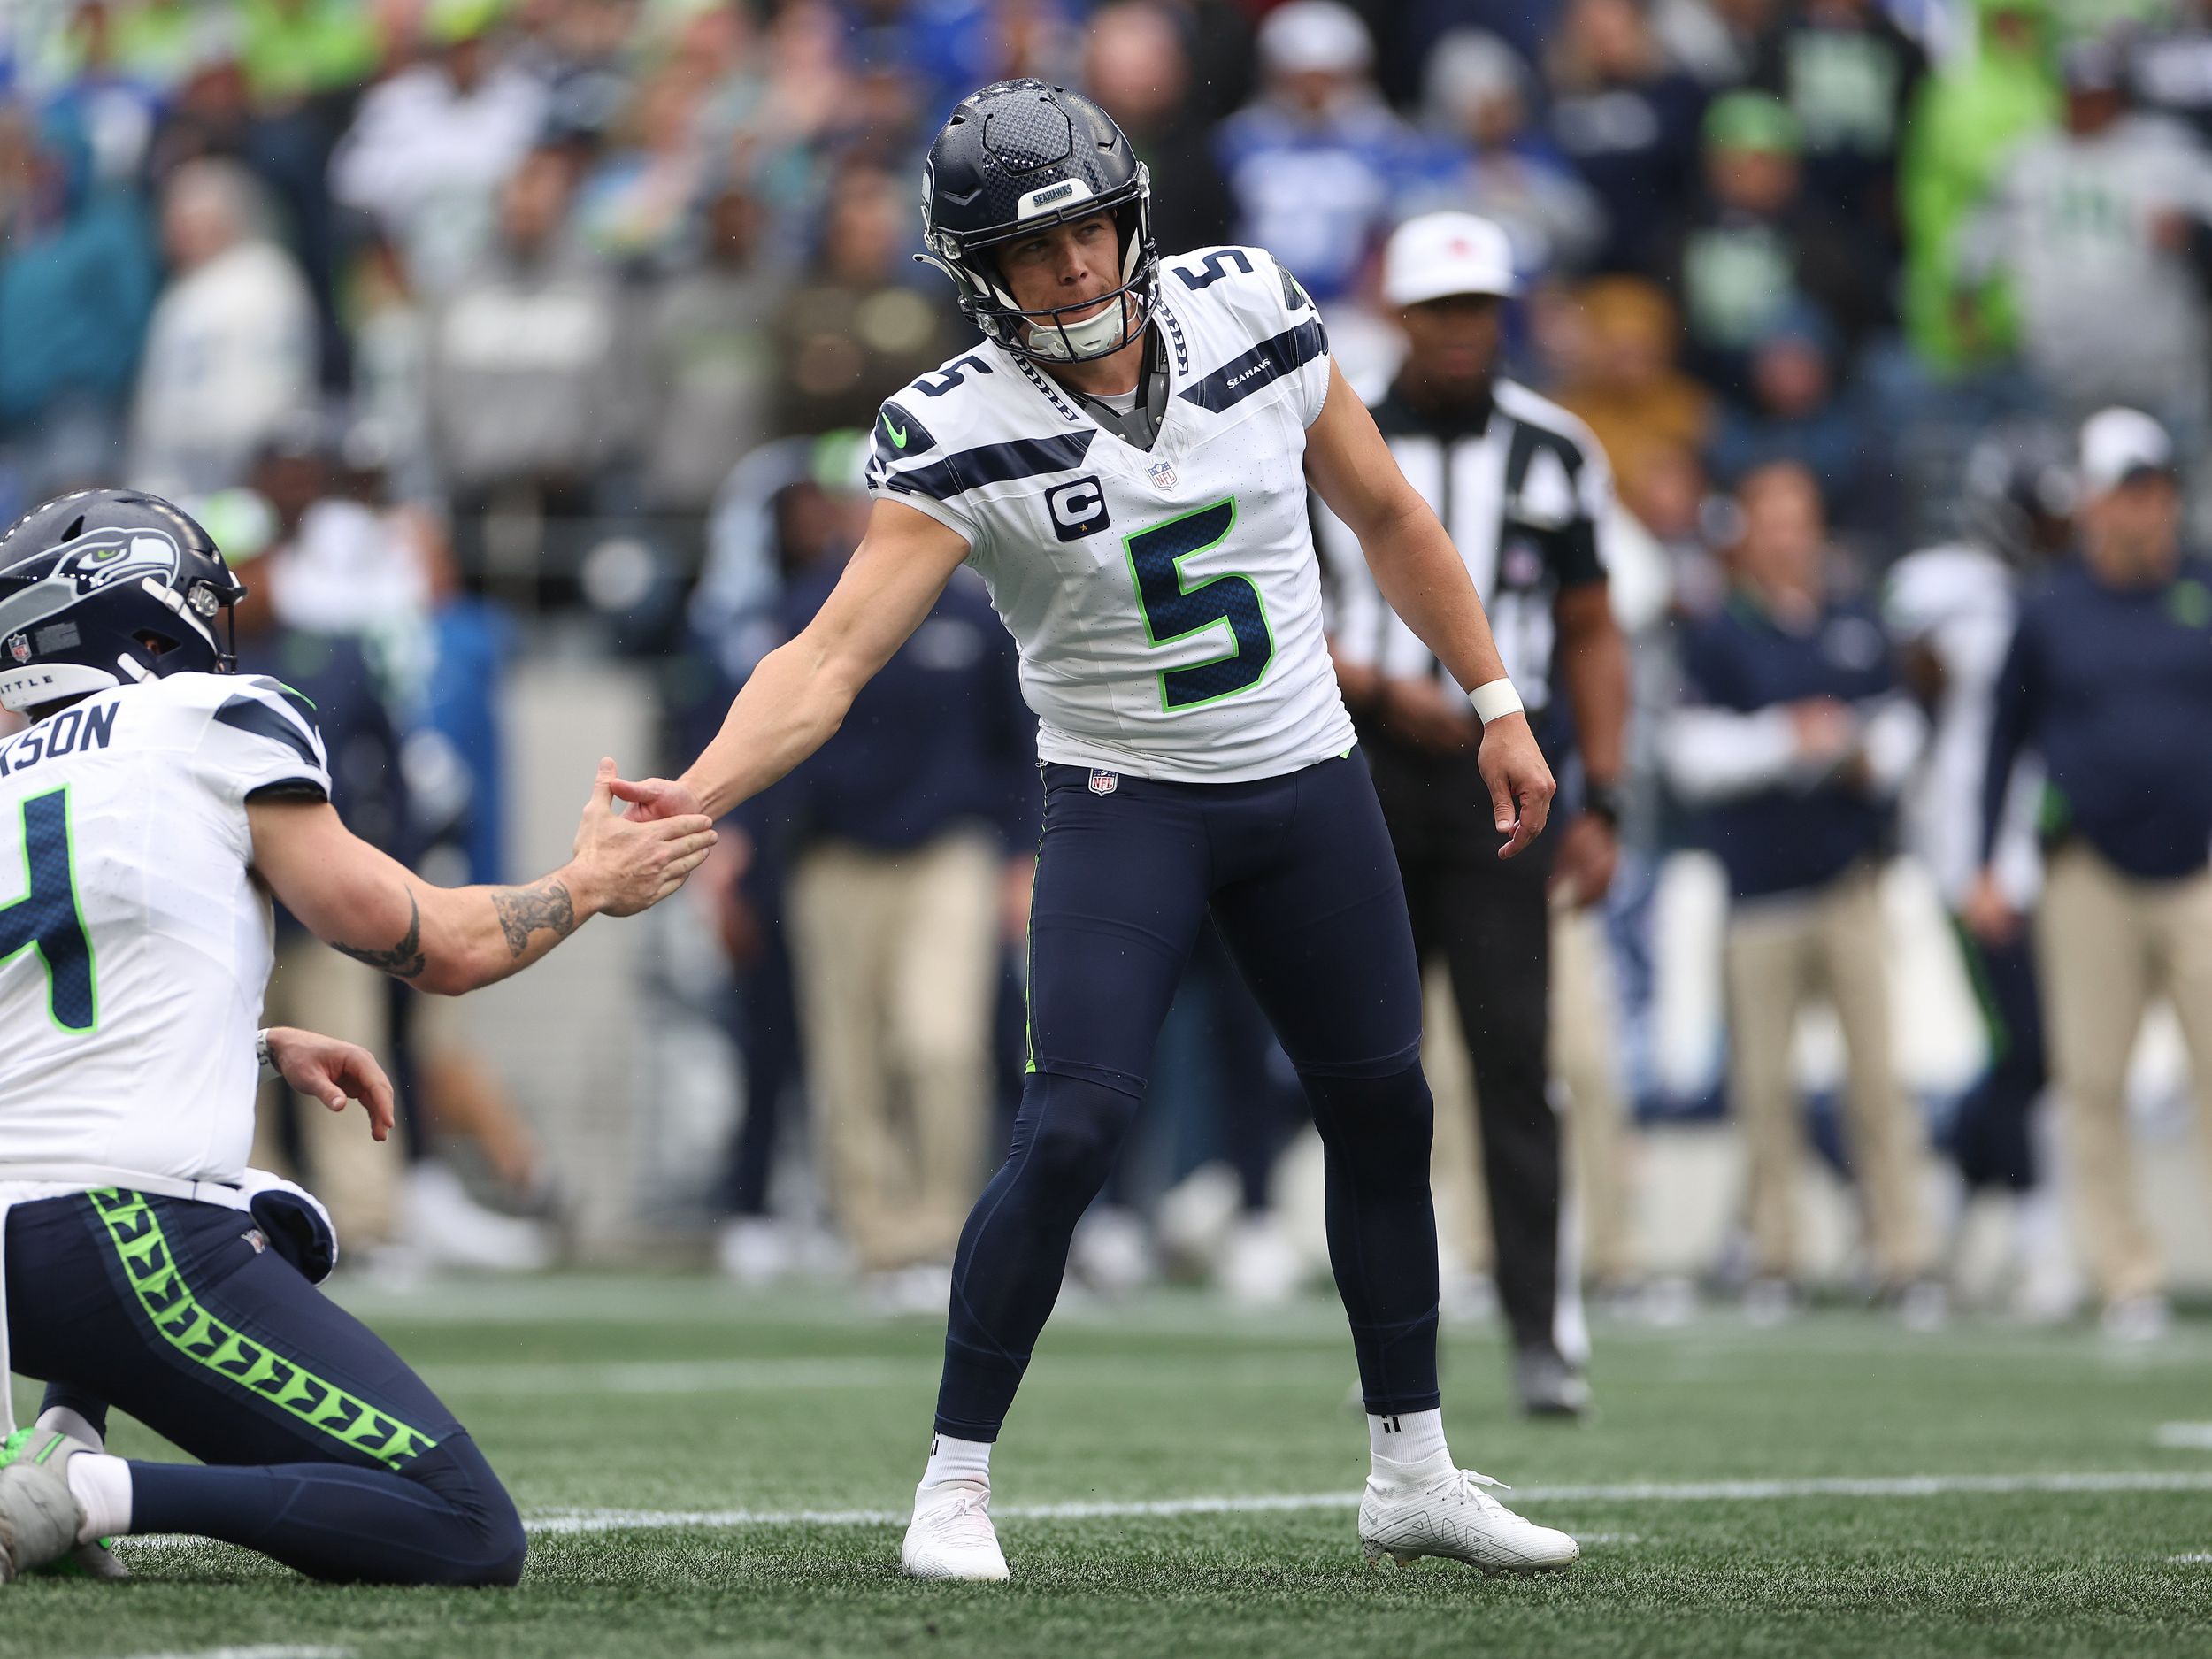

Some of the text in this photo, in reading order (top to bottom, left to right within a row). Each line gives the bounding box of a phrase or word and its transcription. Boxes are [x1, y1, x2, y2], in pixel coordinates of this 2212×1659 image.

[1033, 183, 1073, 207] SEAHAWKS
[1171, 249, 1255, 291] 5
[911, 354, 994, 398] 5
[1155, 471, 1176, 486] NFL
[1051, 481, 1102, 526] C
[1121, 495, 1277, 714] 5
[1092, 776, 1114, 789] NFL
[0, 782, 99, 1036] 4
